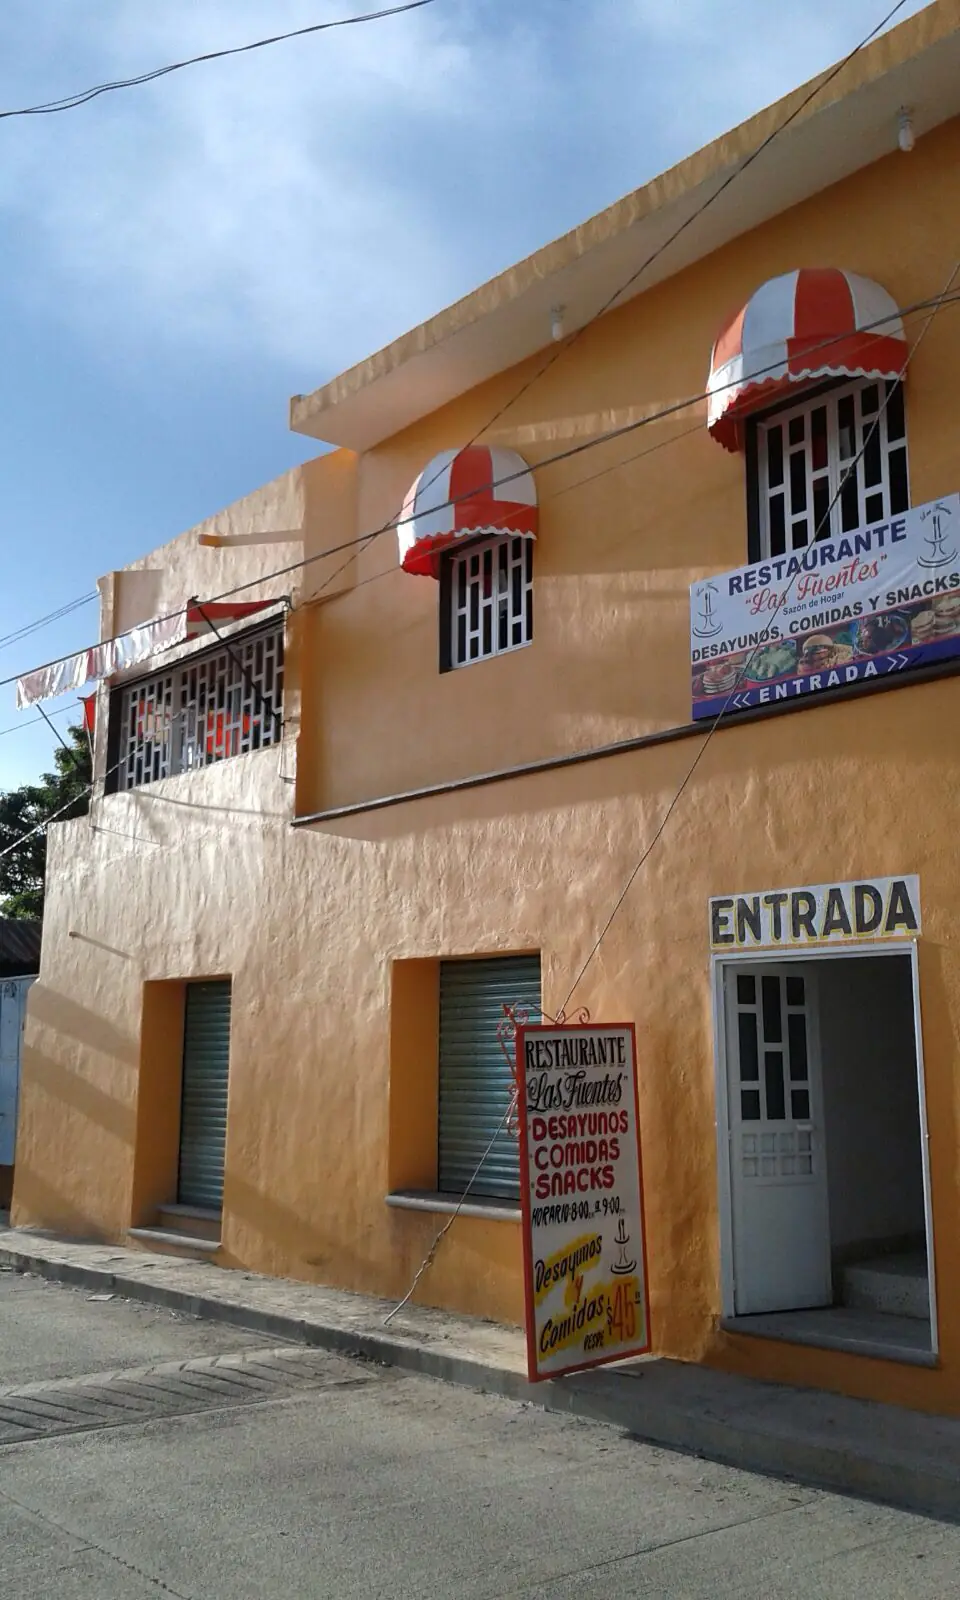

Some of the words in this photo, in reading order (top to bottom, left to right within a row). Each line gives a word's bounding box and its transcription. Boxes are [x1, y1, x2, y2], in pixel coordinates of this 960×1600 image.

[729, 519, 907, 596] RESTAURANTE
[692, 625, 784, 662] DESAYUNOS,
[789, 601, 863, 634] COMIDAS
[869, 595, 880, 611] Y
[886, 572, 960, 606] SNACKS
[809, 599, 819, 610] de
[820, 591, 845, 607] Hogar
[759, 660, 878, 703] ENTRADA
[711, 880, 918, 945] ENTRADA
[526, 1037, 626, 1070] RESTAURANTE
[532, 1110, 628, 1141] DESAYUNOS
[534, 1137, 620, 1170] COMIDAS
[535, 1165, 615, 1199] SNACKS
[535, 1235, 603, 1292] Desayunos
[540, 1294, 604, 1353] Comidas
